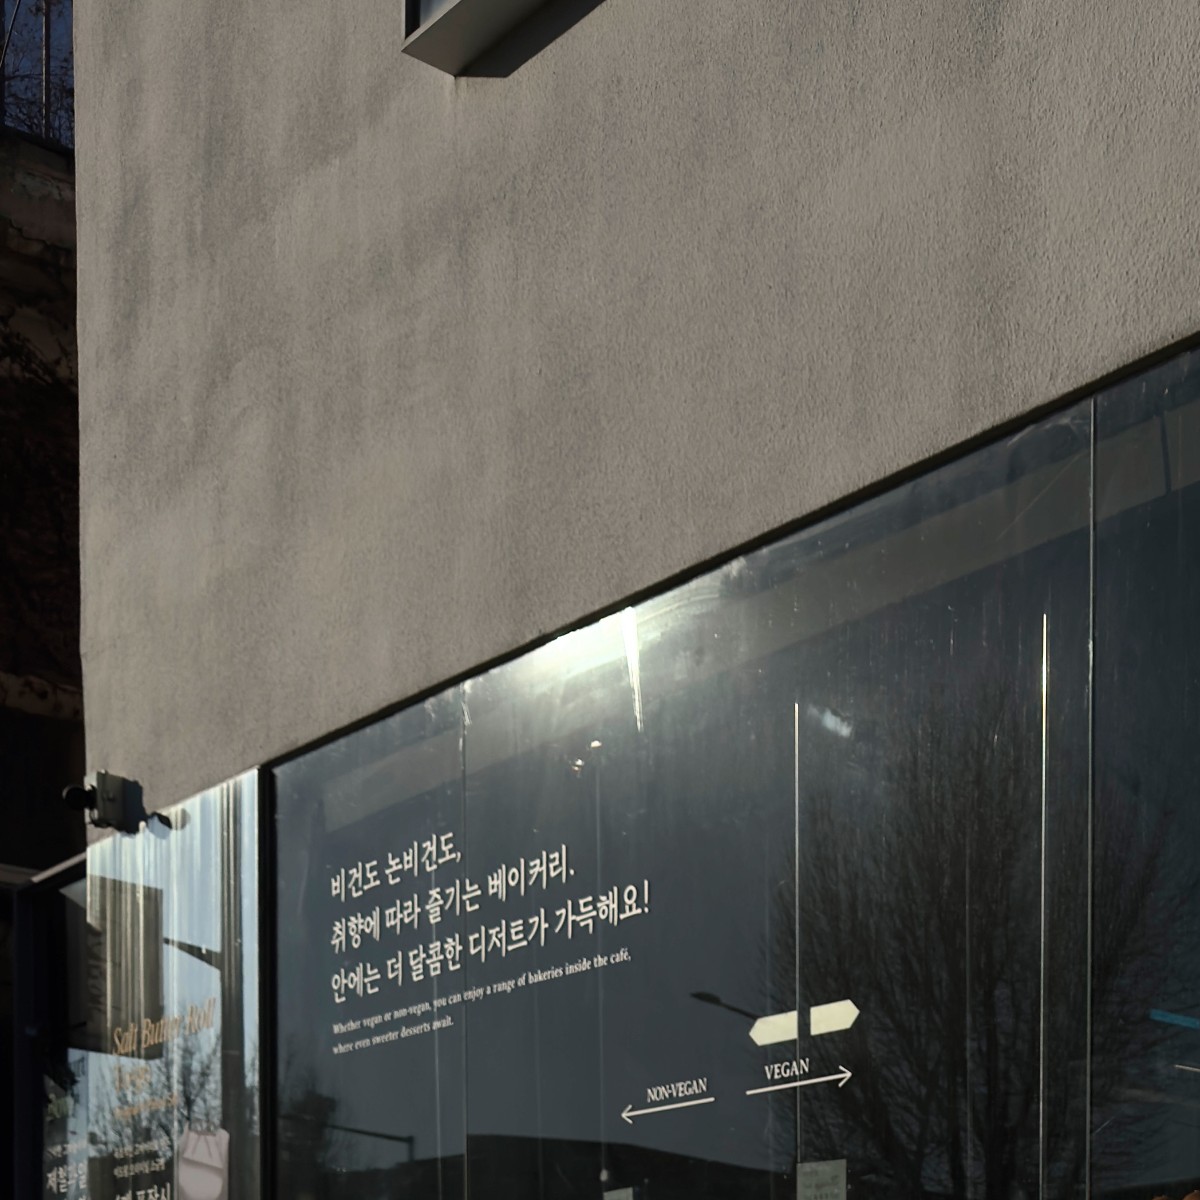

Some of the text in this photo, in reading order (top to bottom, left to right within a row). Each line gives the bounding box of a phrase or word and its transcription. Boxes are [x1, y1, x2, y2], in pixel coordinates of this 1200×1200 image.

[331, 832, 462, 902] 비건도 논비건도,
[331, 843, 575, 954] 취향에 따라 즐기는 베이커리.
[331, 879, 649, 1003] 안에는 더 달콤한 디저트가 가득해요!
[333, 1019, 361, 1034] Whether
[363, 1015, 383, 1029] vegan
[384, 1010, 392, 1021] or
[434, 998, 447, 1012] you
[448, 992, 462, 1004] can
[463, 986, 484, 1002] enjoy
[485, 985, 492, 994] a
[493, 979, 516, 993] range
[517, 973, 527, 987] of
[528, 966, 563, 984] bakeries
[565, 957, 592, 976] inside
[593, 953, 608, 968] the
[333, 1015, 454, 1055] where even sweeter desserts await.
[764, 1057, 810, 1080] VEGAN
[646, 1077, 707, 1103] NON-VEGAN
